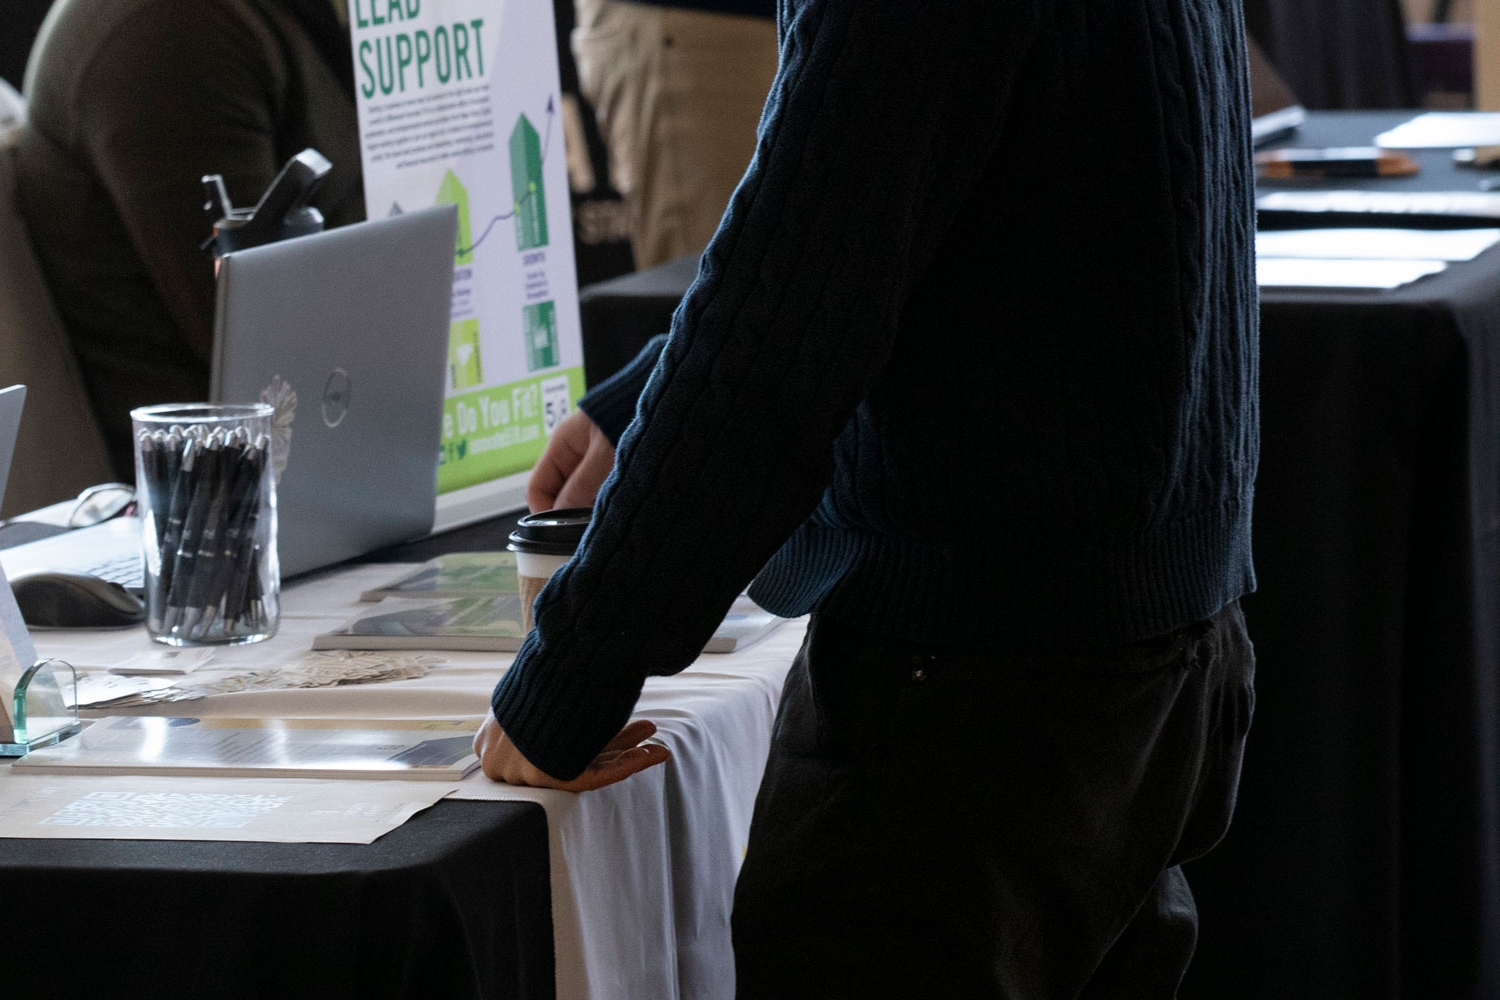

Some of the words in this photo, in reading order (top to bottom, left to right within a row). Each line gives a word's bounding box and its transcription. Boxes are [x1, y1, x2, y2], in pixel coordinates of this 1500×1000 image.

[359, 18, 484, 99] SUPPORT
[456, 402, 477, 436] Do
[478, 396, 510, 429] You
